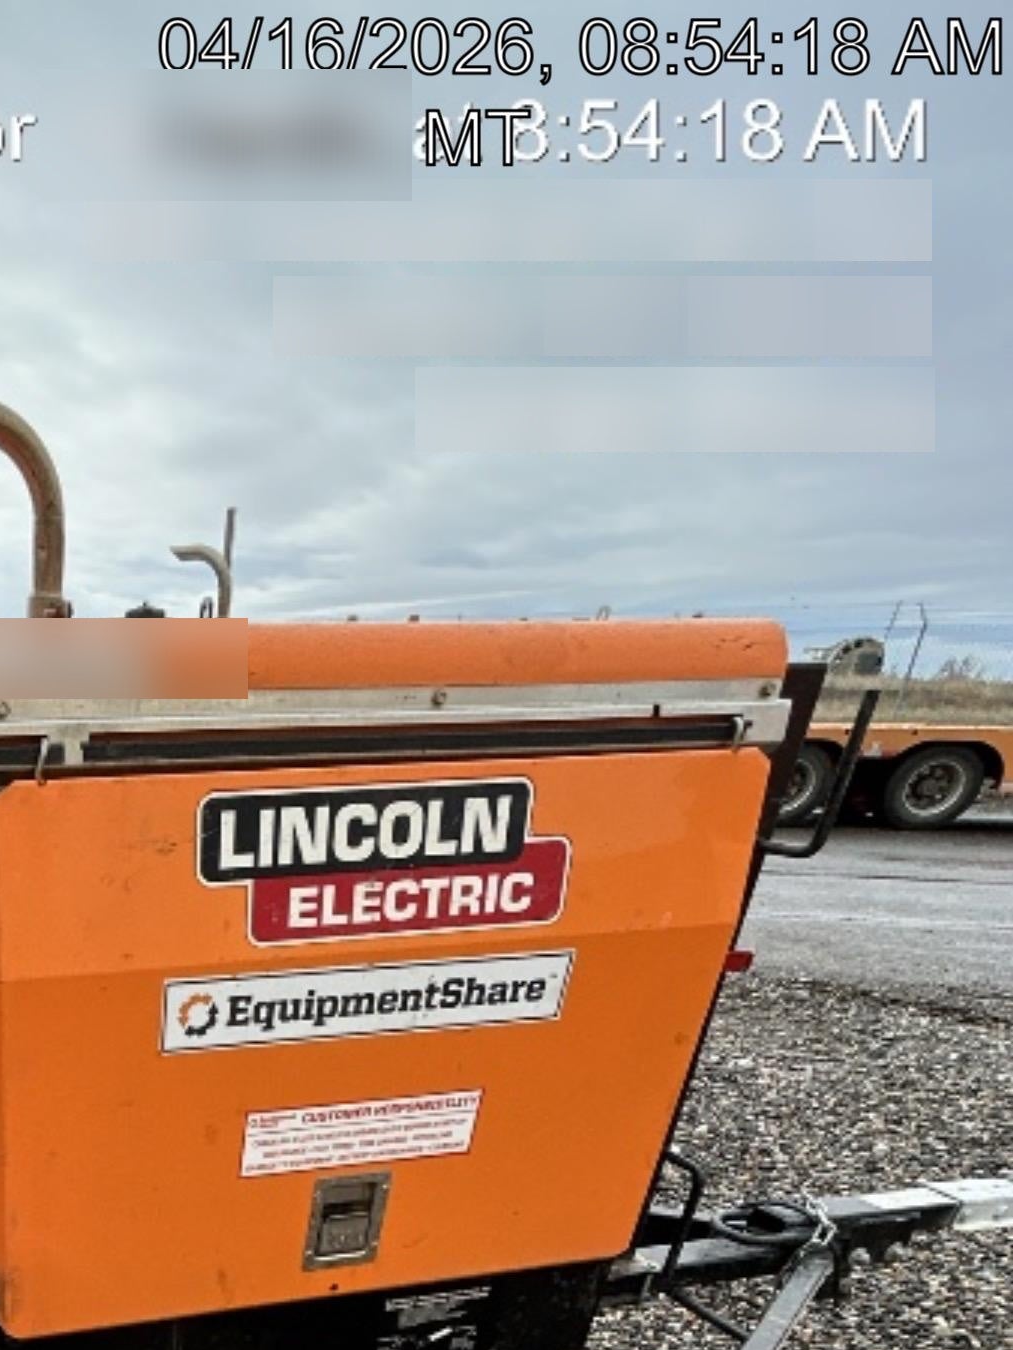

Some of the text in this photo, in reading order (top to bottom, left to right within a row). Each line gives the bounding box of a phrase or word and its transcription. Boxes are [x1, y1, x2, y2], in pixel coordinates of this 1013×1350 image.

[218, 794, 514, 871] LINCOLN
[287, 871, 533, 928] ELECTRIC
[226, 976, 547, 1032] EquipmentShare
